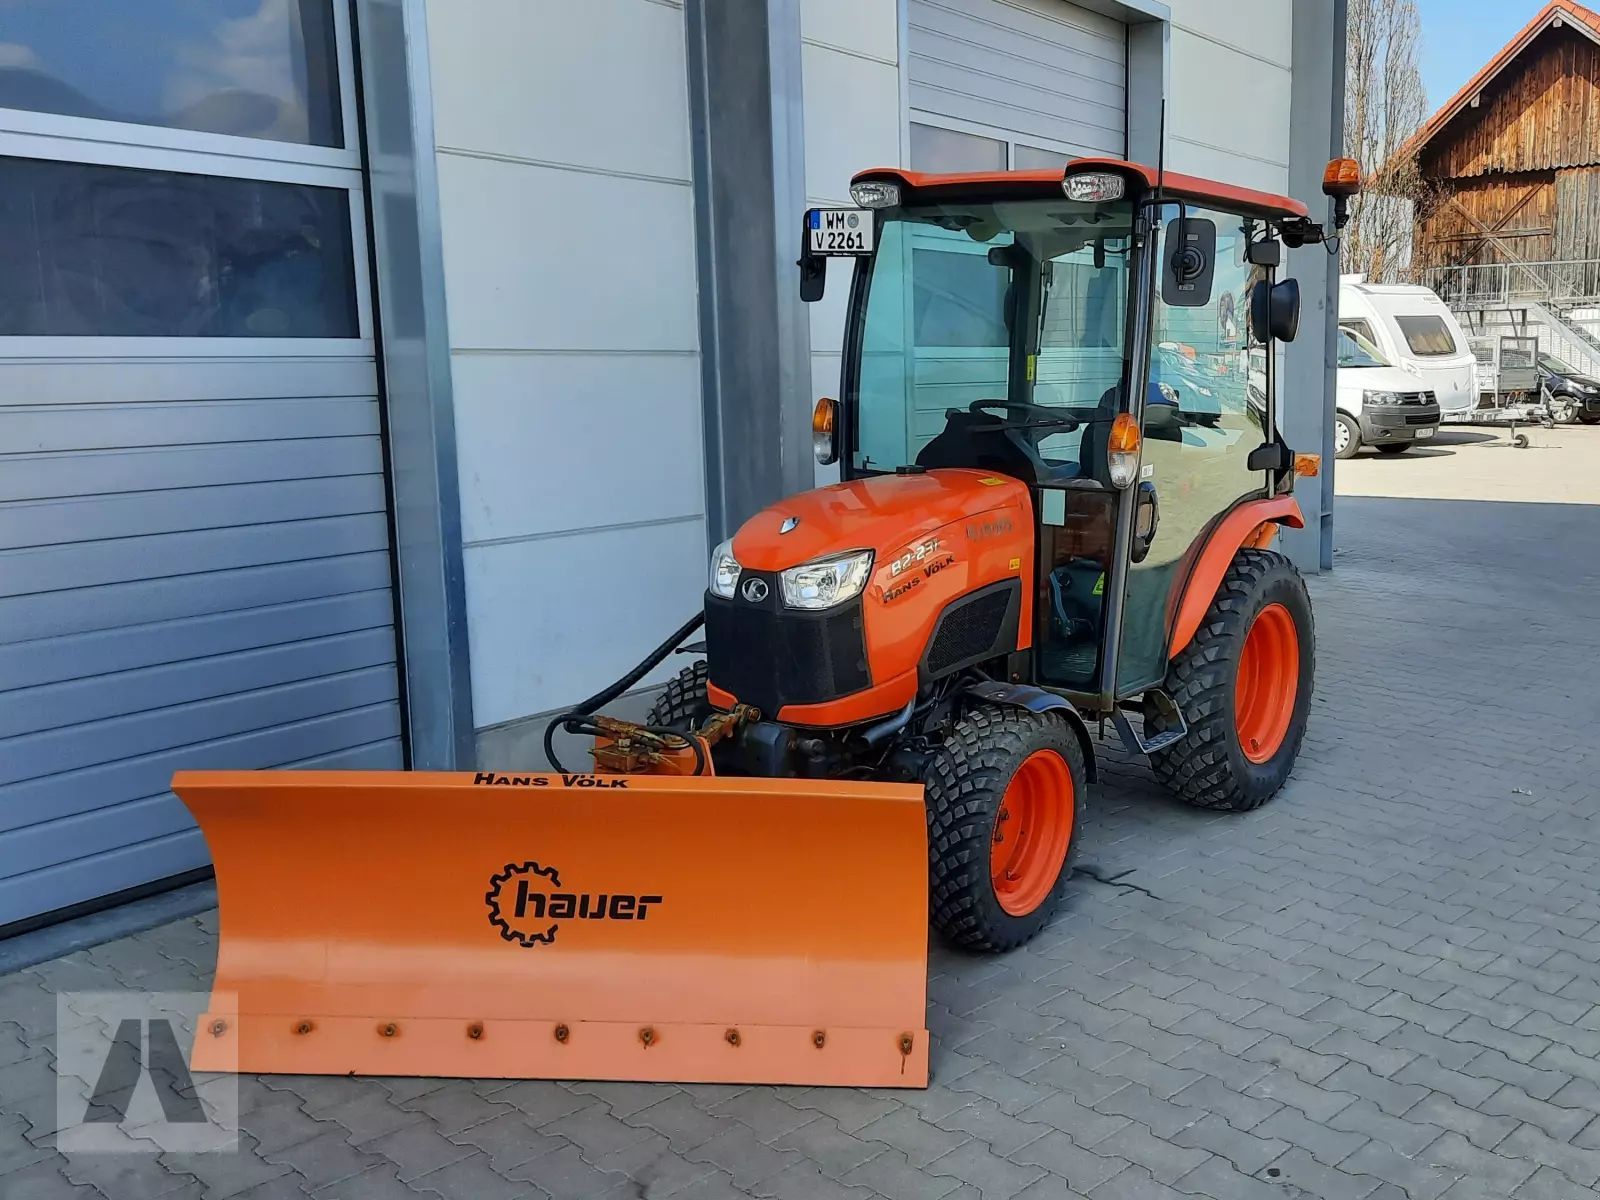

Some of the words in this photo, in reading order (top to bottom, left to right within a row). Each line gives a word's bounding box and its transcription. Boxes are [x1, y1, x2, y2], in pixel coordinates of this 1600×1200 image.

[826, 212, 845, 230] WM
[816, 232, 824, 249] V
[828, 232, 865, 249] 2261
[473, 773, 549, 786] HANS
[561, 774, 629, 788] VÖLK
[514, 880, 663, 920] hauer
